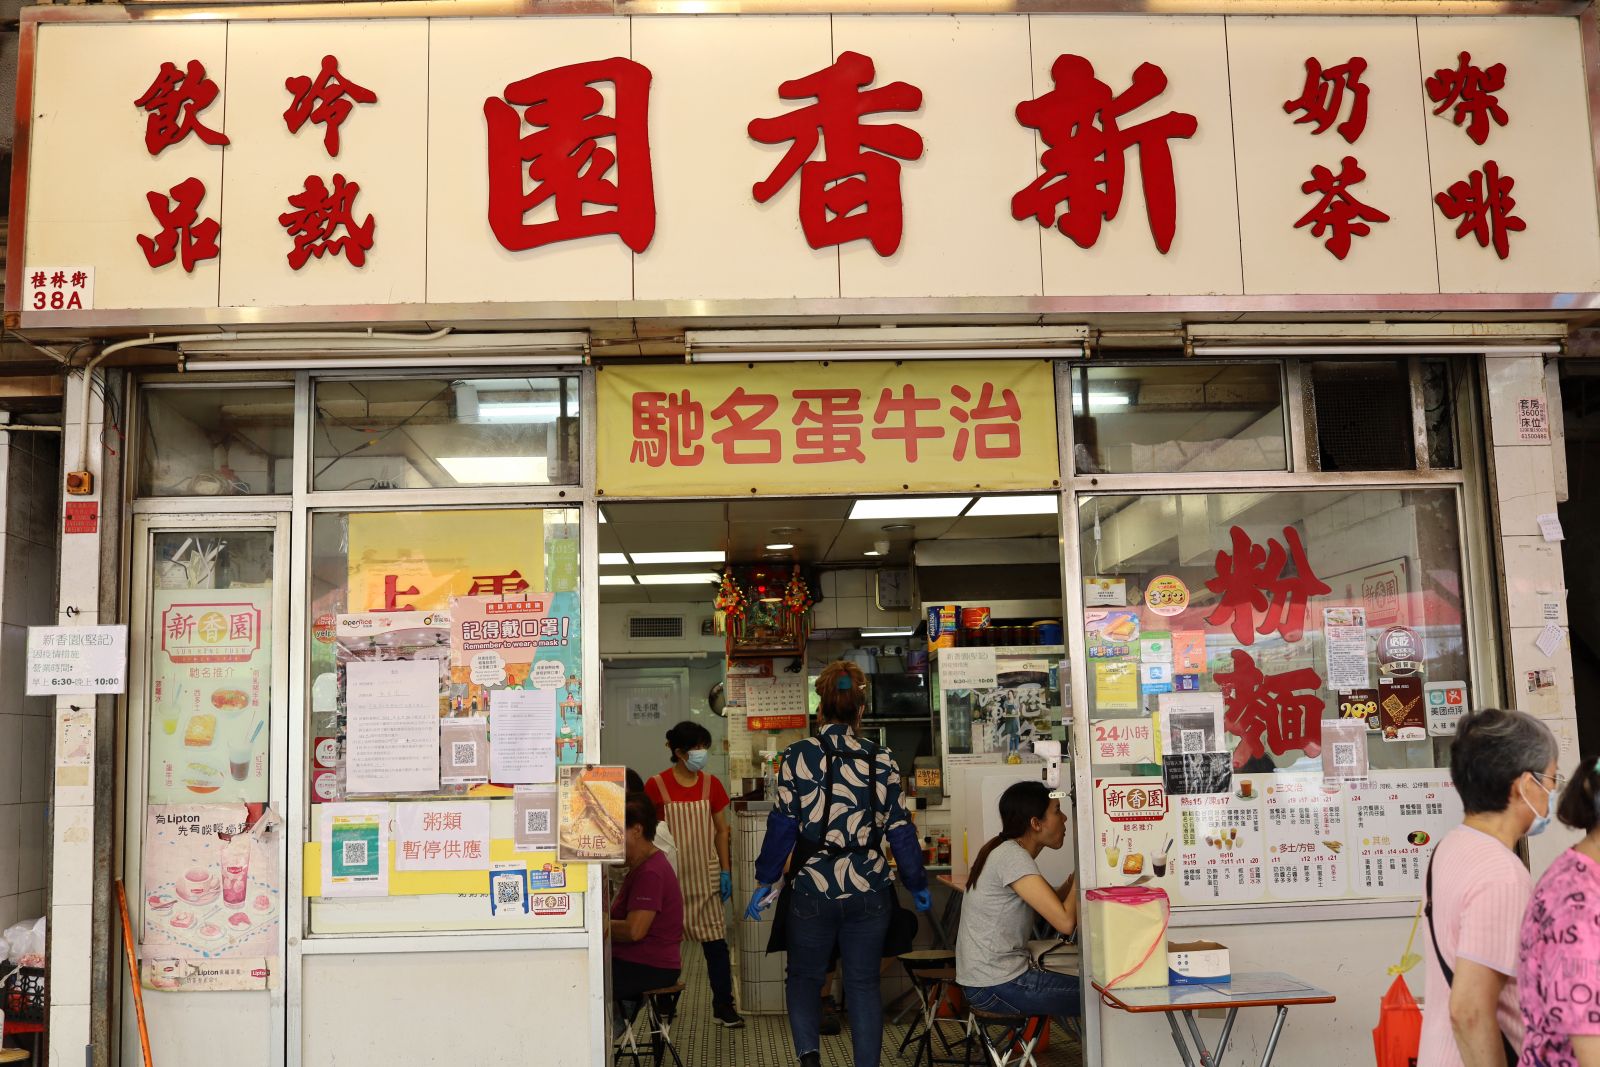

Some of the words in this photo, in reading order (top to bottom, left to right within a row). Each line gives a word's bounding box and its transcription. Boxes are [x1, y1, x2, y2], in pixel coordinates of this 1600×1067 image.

[279, 55, 376, 271] 冷熱
[1283, 56, 1390, 260] 奶茶
[135, 59, 230, 273] 飲品
[30, 271, 88, 289] 桂林街
[33, 291, 82, 310] 38A
[1521, 409, 1540, 417] 3600
[1521, 418, 1541, 427] 床位
[167, 611, 253, 644] 新香園
[464, 641, 502, 651] Remember
[503, 640, 512, 649] to
[512, 640, 534, 649] wear
[538, 639, 559, 647] mask
[94, 678, 119, 686] 10:00
[1431, 705, 1464, 716] 美团点评
[1095, 726, 1149, 741] 24小時
[1100, 743, 1131, 757] 營業
[1275, 783, 1303, 793] 三文治
[1107, 788, 1163, 809] 新香園
[423, 811, 463, 831] 粥類
[577, 834, 607, 849] 烘底
[1279, 843, 1316, 854] 多士/方包
[402, 840, 482, 859] 暫停供應
